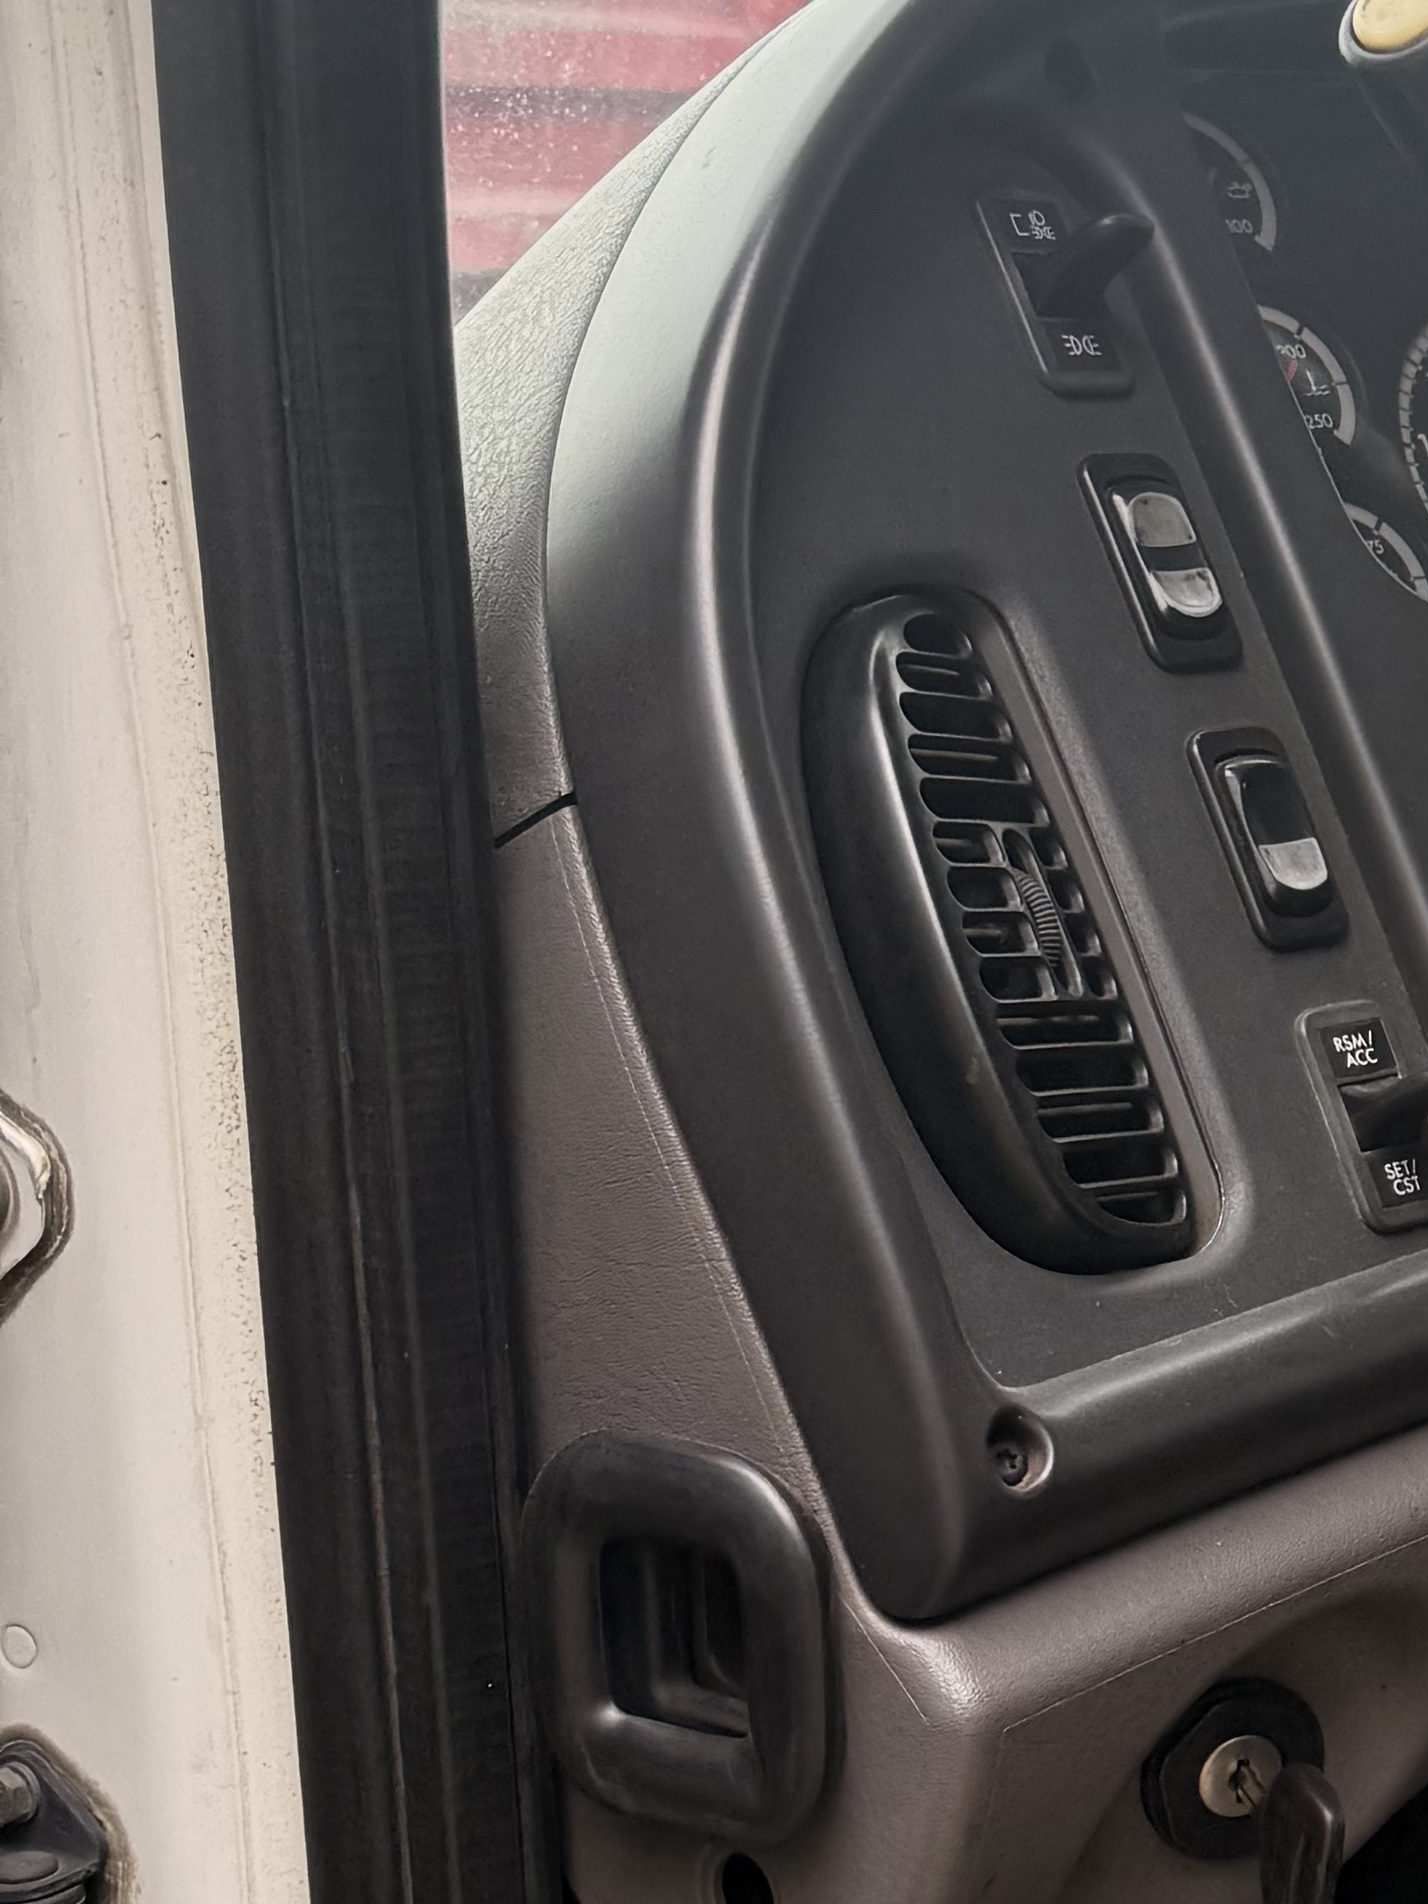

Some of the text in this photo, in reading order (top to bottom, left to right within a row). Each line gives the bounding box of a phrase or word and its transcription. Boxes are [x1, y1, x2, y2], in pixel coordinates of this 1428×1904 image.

[1333, 1030, 1374, 1054] RSM/
[1346, 1047, 1378, 1068] ACC
[1384, 1158, 1417, 1181] SET/
[1392, 1175, 1421, 1196] CST
